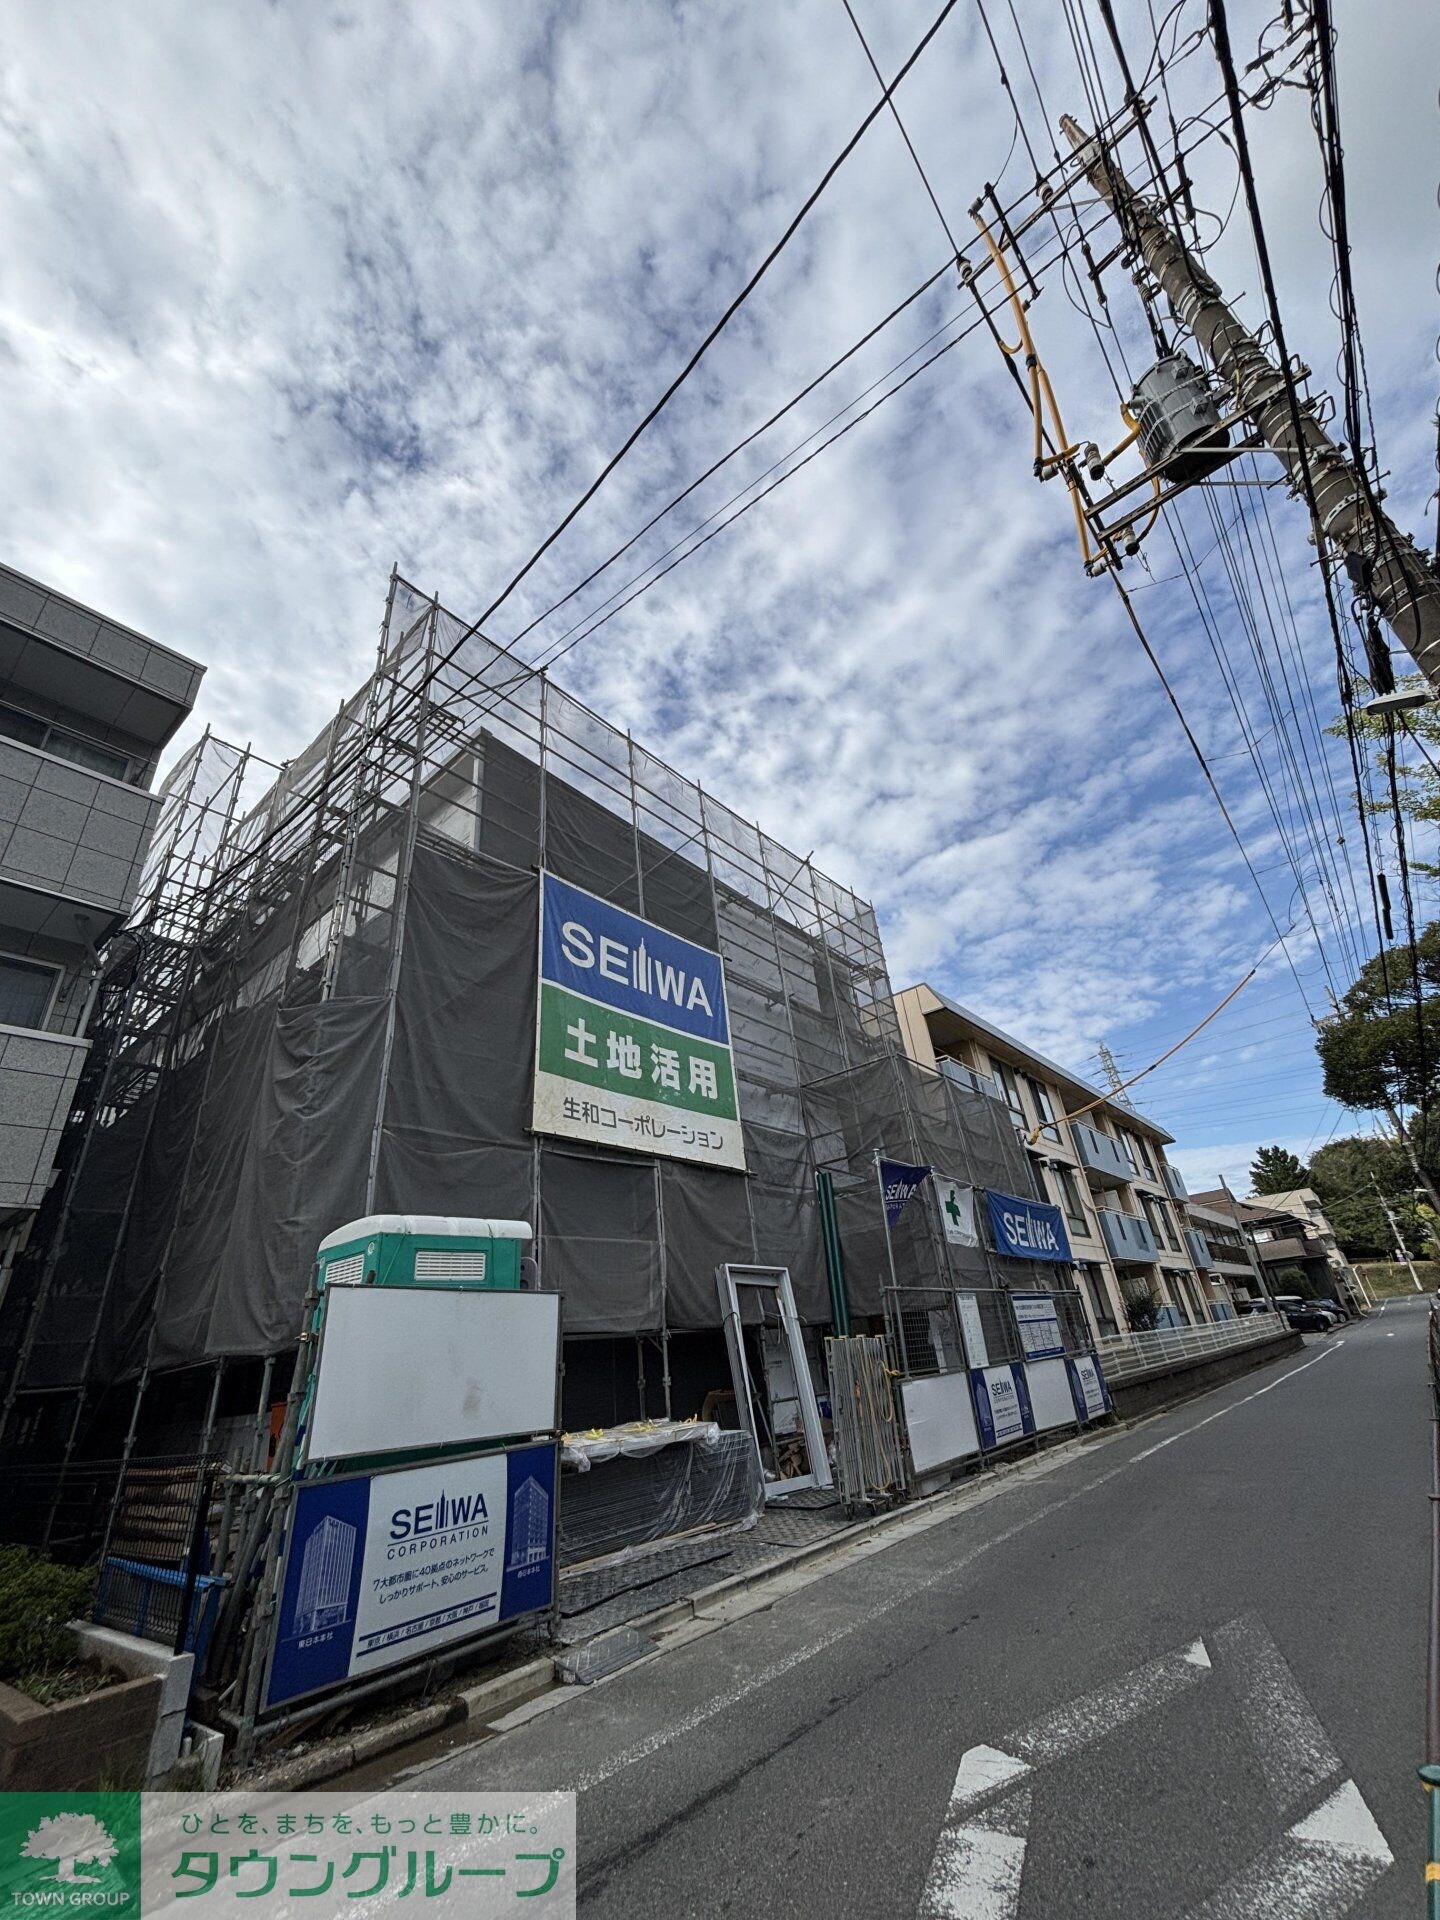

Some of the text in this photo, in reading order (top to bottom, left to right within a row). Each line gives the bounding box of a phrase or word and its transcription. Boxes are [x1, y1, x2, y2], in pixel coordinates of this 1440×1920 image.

[561, 921, 713, 1017] SEIWA
[564, 1018, 718, 1099] 土地活用
[563, 1096, 724, 1150] 生和コーポレーション
[1003, 1206, 1060, 1251] SEIWA
[389, 1490, 489, 1540] SEIWA
[387, 1526, 489, 1560] CORPORATION
